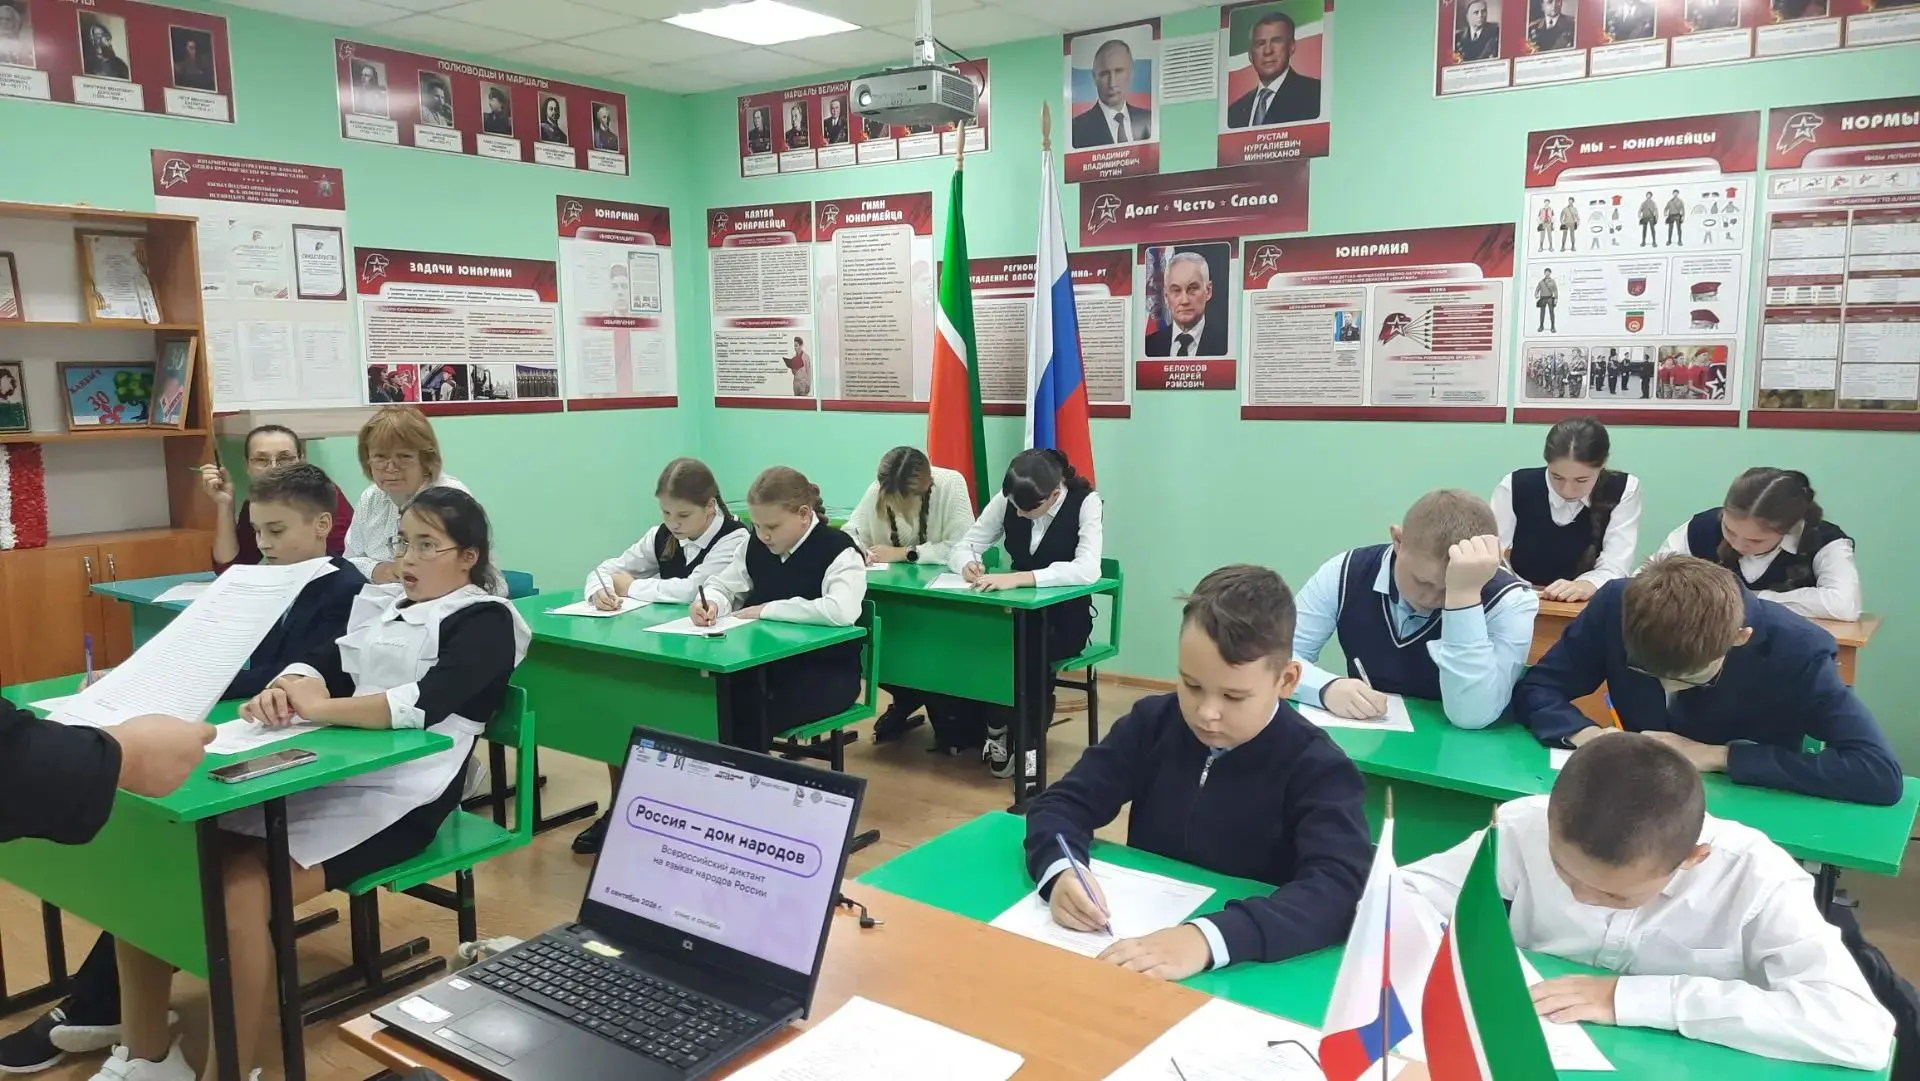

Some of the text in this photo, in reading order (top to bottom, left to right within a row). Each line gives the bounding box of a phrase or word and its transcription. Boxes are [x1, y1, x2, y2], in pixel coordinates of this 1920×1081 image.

[438, 60, 549, 88] ПОЛКОВОДЦЫ И МАРШАЛЫ
[784, 81, 849, 100] МАРШАЛЫ ВЕЛИКОЙ
[1841, 111, 1919, 130] НОРМЫ
[1256, 131, 1289, 142] РУСТАМ
[1579, 142, 1603, 154] МЫ
[1622, 132, 1716, 150] ЮНАРМЕЙЦЫ
[1243, 139, 1301, 153] НУРГАЛИЕВИЧ
[1092, 150, 1130, 161] ВЛАДИМИР
[1244, 149, 1300, 161] МИННИХАНОВ
[1082, 158, 1140, 171] ВЛАДИМИРОВИЧ
[1100, 168, 1122, 178] ПУТИН
[861, 199, 886, 211] ГИМН
[1124, 193, 1279, 219] Долг Честь Слава
[595, 208, 640, 221] ЮНАРМИЯ
[744, 209, 774, 219] КЛЯТВА
[845, 210, 903, 224] ЮНАРМЕЙЦА
[734, 218, 786, 231] ЮНАРМЕЙЦА
[1335, 242, 1409, 258] ЮНАРМИЯ
[409, 262, 512, 278] ЗАДАЧИ ЮНАРМИИ
[1163, 364, 1208, 372] БЕЛОУСОВ
[1169, 372, 1202, 381] АНДРЕЙ
[1165, 380, 1205, 388] РЭМОВИЧ
[635, 804, 687, 830] Россия
[704, 827, 736, 844] дом
[739, 836, 806, 865] народов
[661, 844, 766, 883] Всероссийский диктант
[653, 857, 768, 898] на языках народов России
